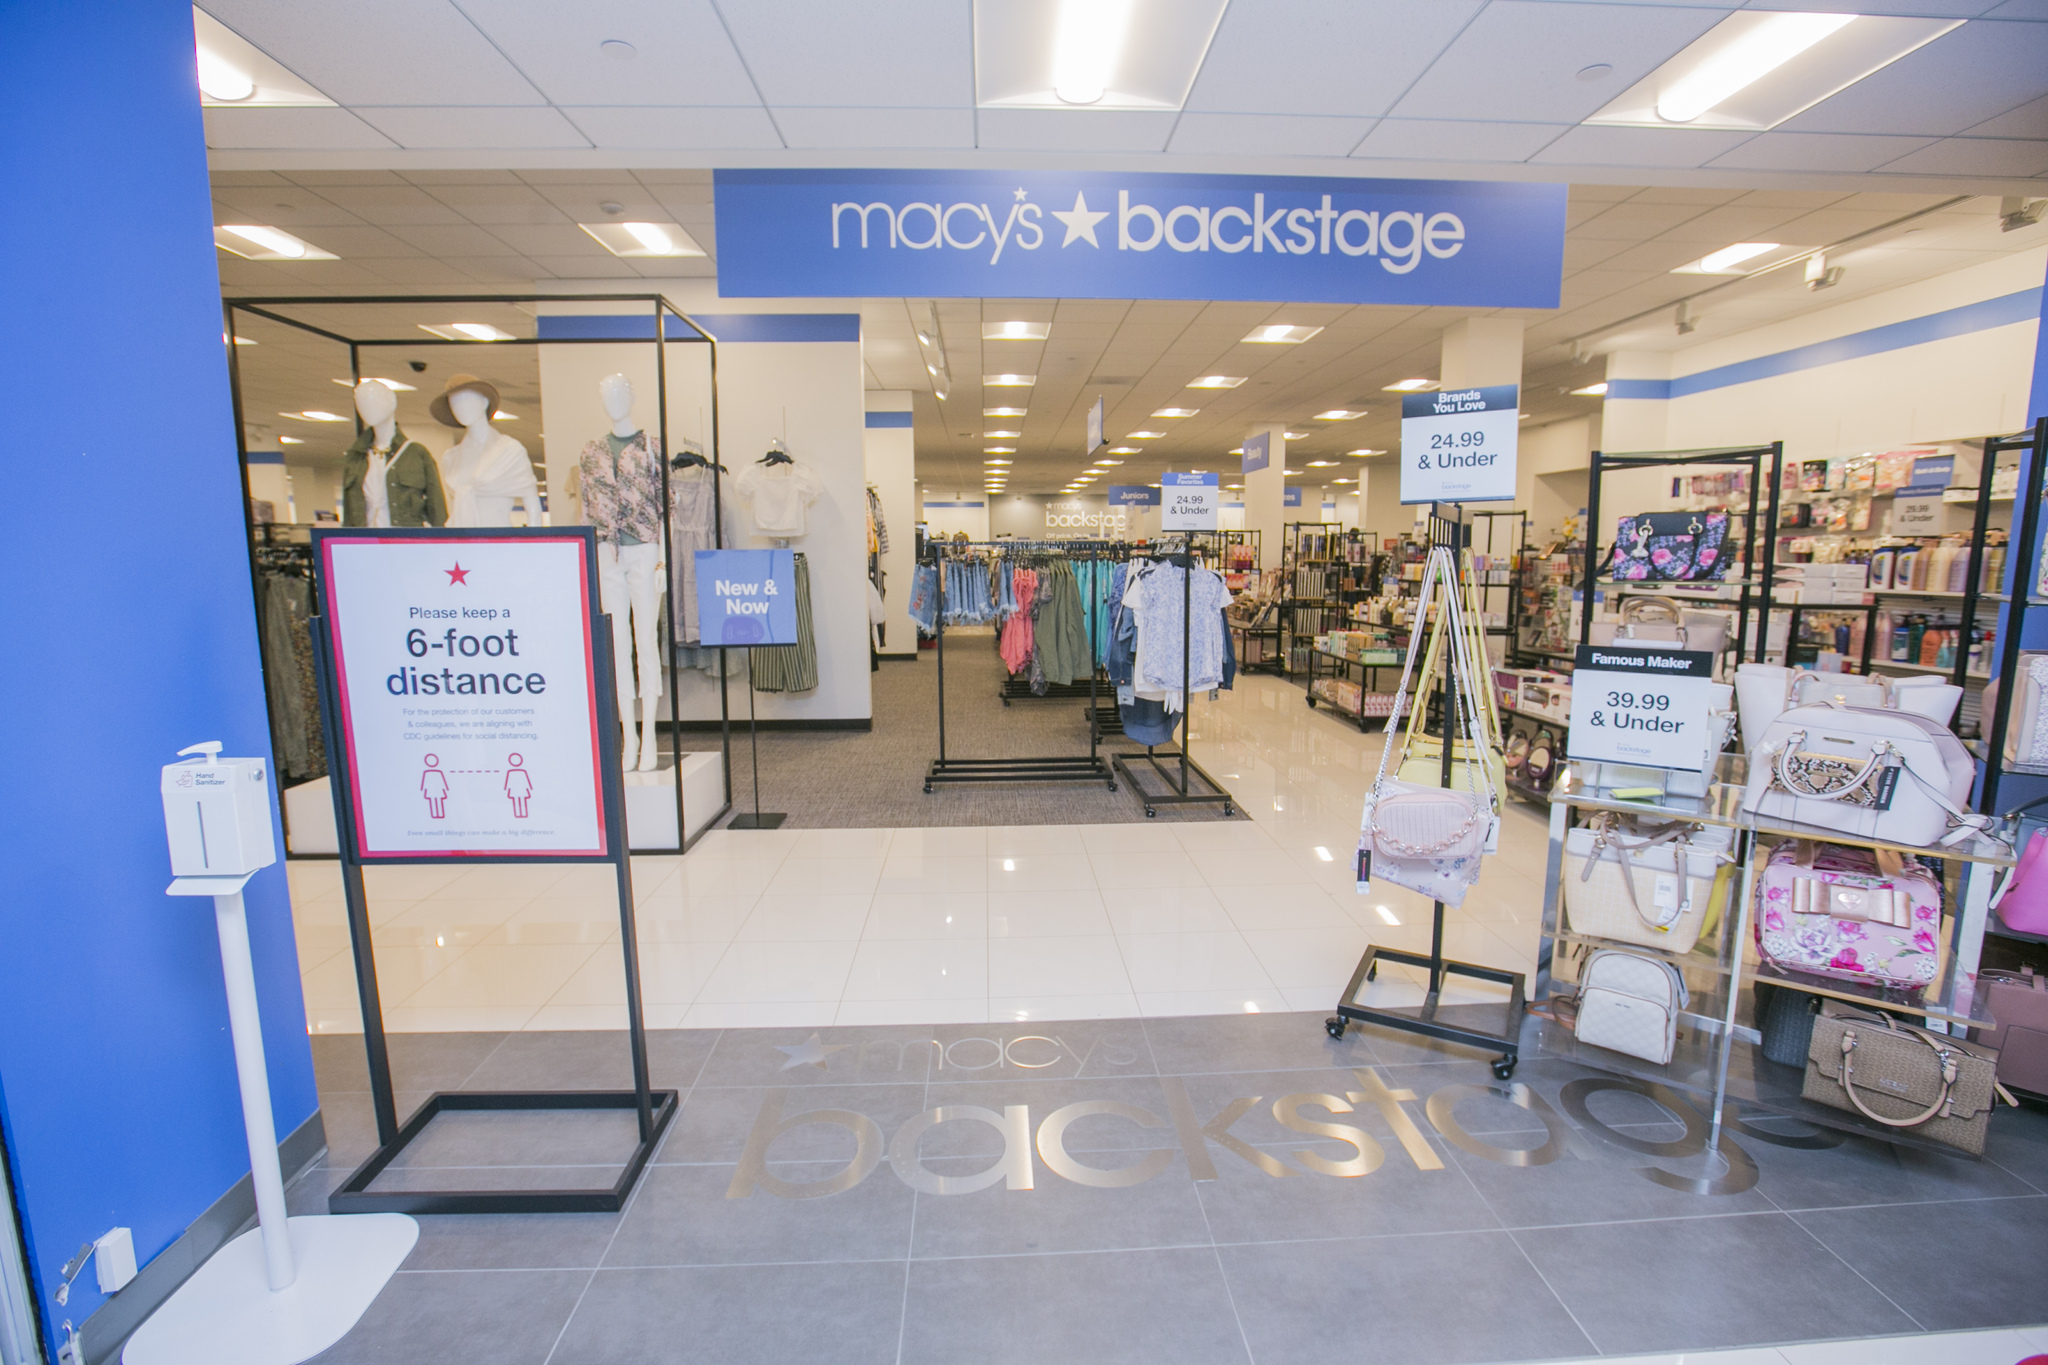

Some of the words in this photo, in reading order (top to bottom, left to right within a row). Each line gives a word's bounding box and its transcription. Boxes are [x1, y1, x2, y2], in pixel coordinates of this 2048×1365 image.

[1118, 190, 1465, 275] backstage
[1438, 390, 1481, 403] Brands
[1432, 402, 1455, 414] You
[1457, 401, 1486, 411] Love
[1430, 431, 1485, 449] 24.99
[1418, 454, 1431, 470] &
[1438, 451, 1498, 469] Under
[1120, 491, 1149, 500] Juniors
[1177, 495, 1203, 504] 24.99
[1170, 506, 1178, 514] &
[1180, 506, 1209, 515] Under
[1907, 514, 1935, 522] Under
[1045, 511, 1126, 531] backstag
[715, 580, 758, 596] New
[763, 579, 778, 595] &
[409, 607, 457, 619] Please
[462, 606, 497, 621] keep
[502, 609, 511, 619] a
[726, 599, 769, 615] Now
[406, 628, 519, 658] 6-foot
[1591, 653, 1645, 667] Famous
[1647, 655, 1692, 669] Maker
[386, 666, 546, 696] distance
[1606, 691, 1670, 711] 39.99
[402, 708, 415, 716] For
[417, 708, 430, 716] the
[431, 708, 469, 717] protection
[471, 707, 478, 715] of
[495, 707, 535, 715] customers
[415, 720, 457, 729] colleagues,
[486, 720, 515, 729] aligning
[1590, 710, 1606, 727] &
[1614, 712, 1685, 733] Under
[424, 732, 461, 741] guidelines
[462, 732, 473, 740] for
[475, 732, 497, 740] social
[498, 732, 539, 740] distancing.
[508, 829, 519, 837] big
